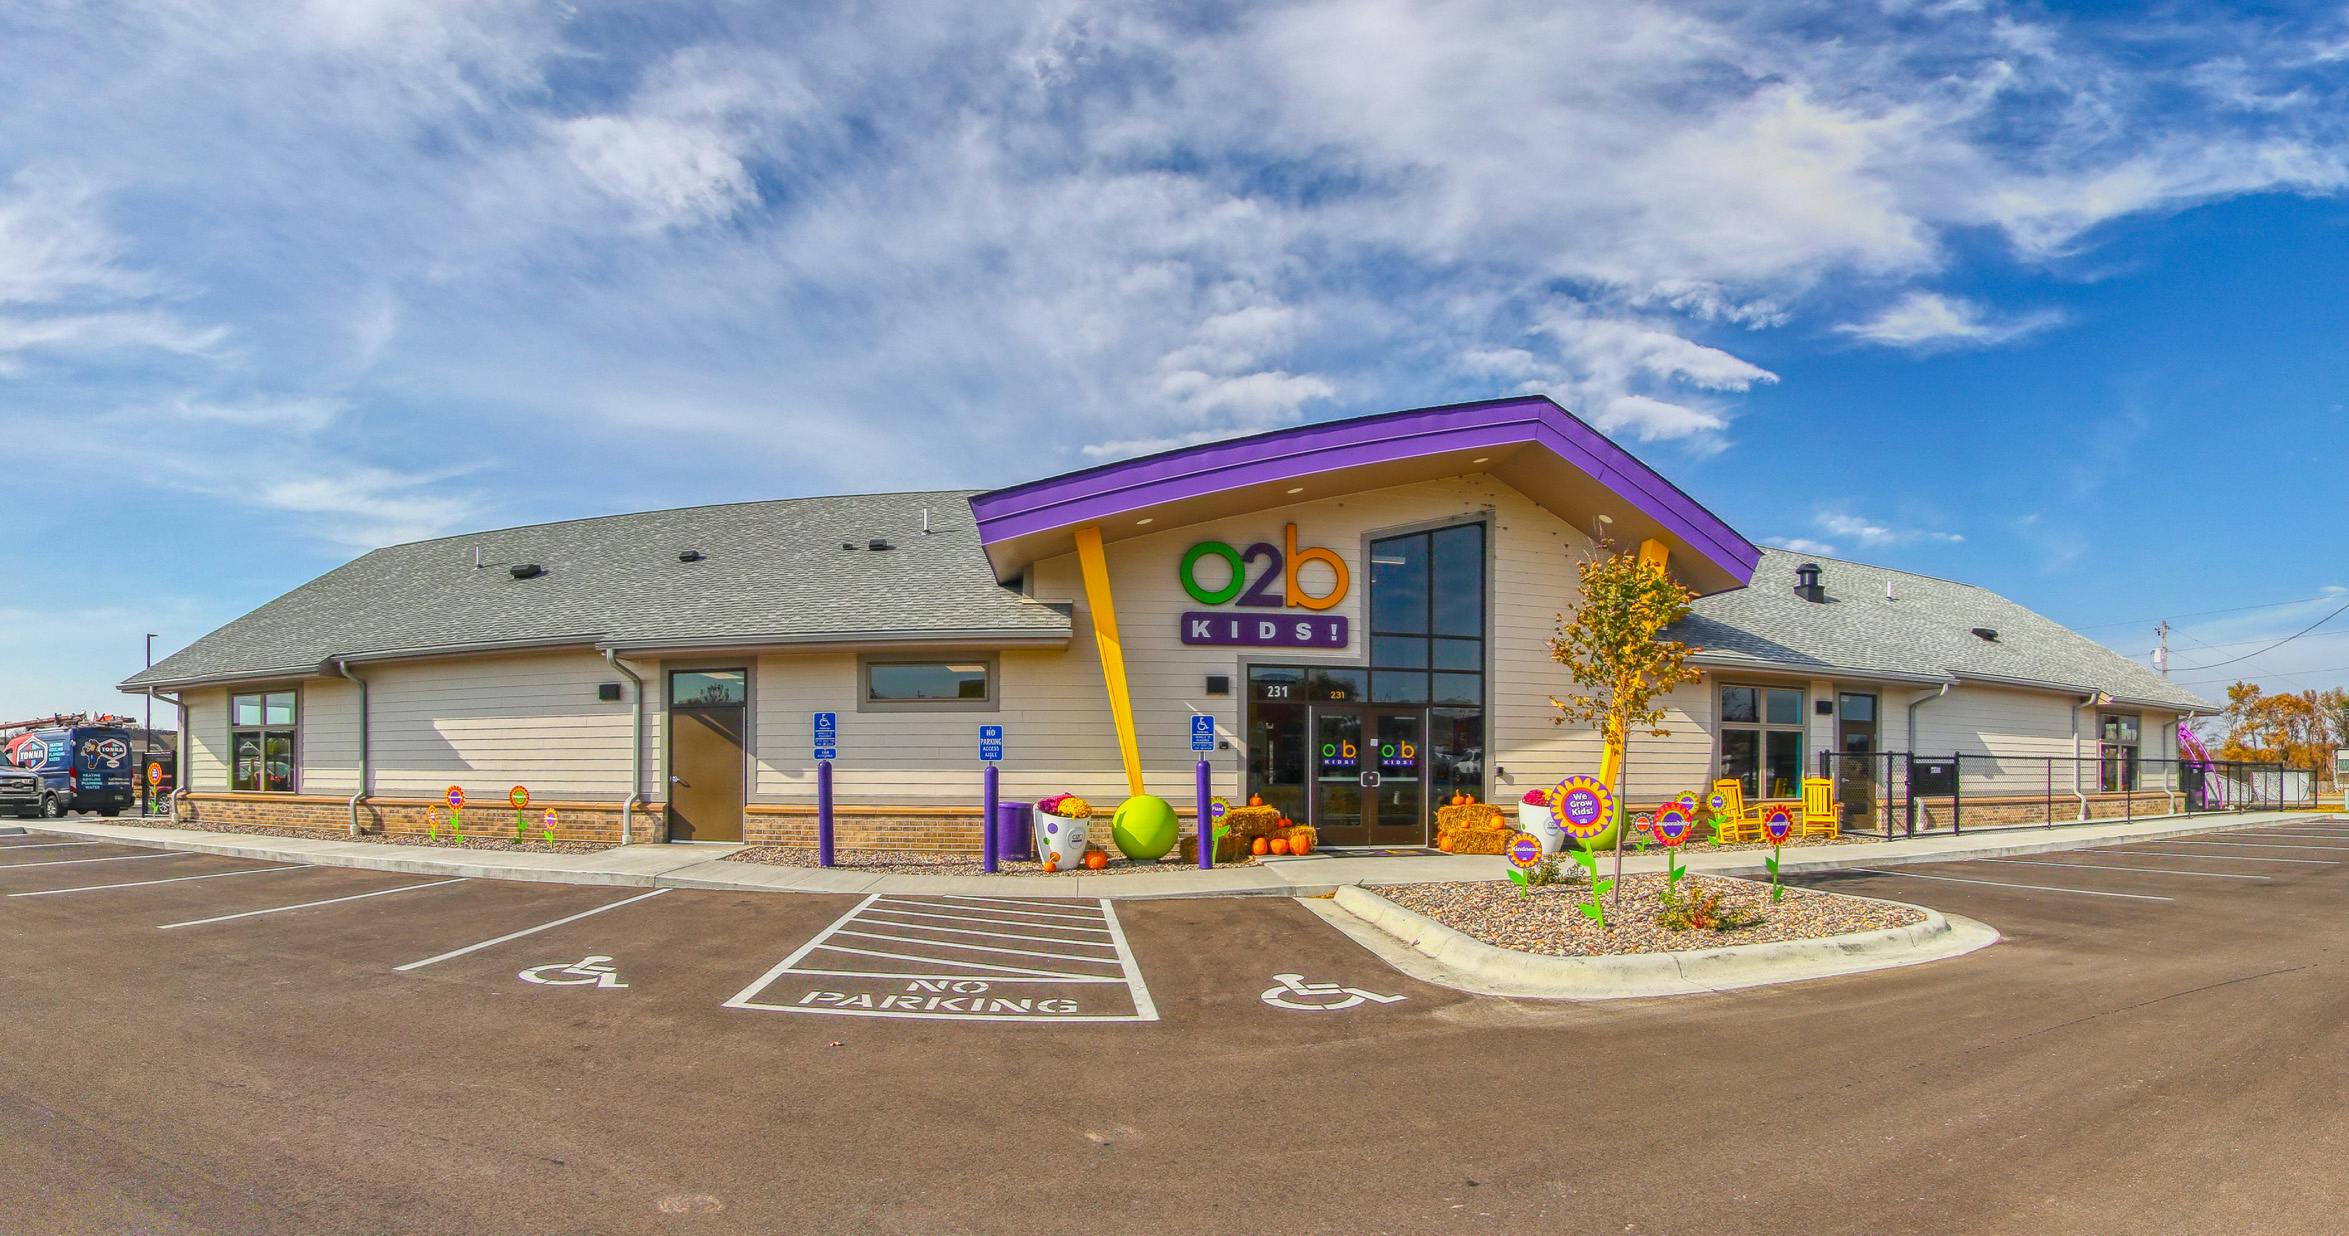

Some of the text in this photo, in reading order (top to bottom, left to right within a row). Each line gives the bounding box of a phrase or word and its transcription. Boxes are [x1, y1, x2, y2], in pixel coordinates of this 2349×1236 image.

[1180, 523, 1349, 610] o2b
[1191, 619, 1339, 642] KIDS!
[1267, 685, 1288, 698] 231
[1330, 691, 1345, 699] 231
[1570, 800, 1593, 808] Grow
[1572, 808, 1594, 816] Kids!
[905, 979, 991, 994] NO
[799, 990, 1080, 1014] PARKING
